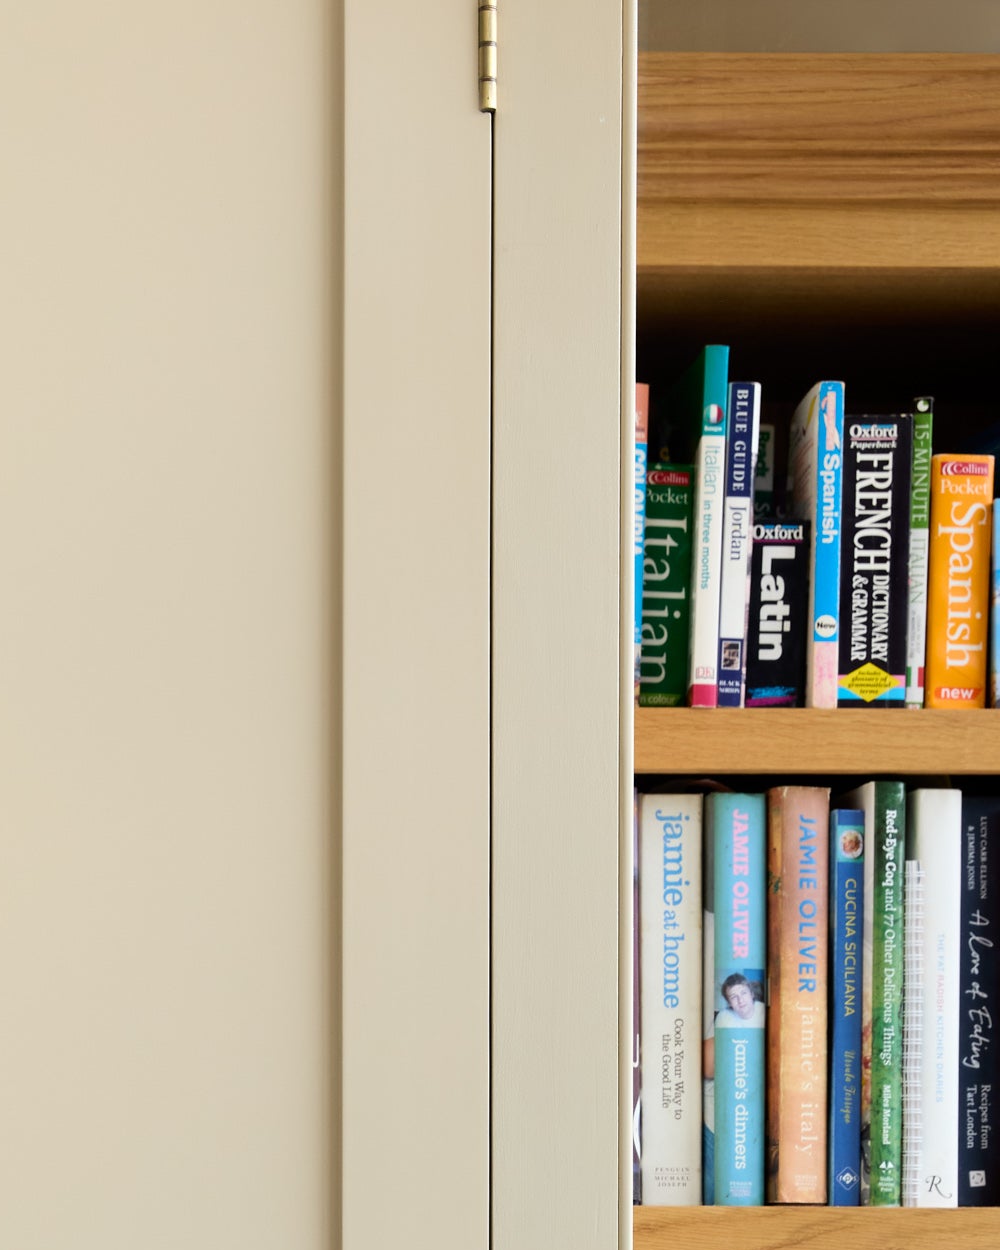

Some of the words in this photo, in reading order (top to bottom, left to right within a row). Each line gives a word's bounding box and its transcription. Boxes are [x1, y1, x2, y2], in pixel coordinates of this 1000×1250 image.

[735, 389, 749, 433] BLUE
[850, 424, 898, 438] Oxford
[850, 440, 897, 450] Paperback
[654, 473, 689, 485] Collins
[704, 445, 721, 494] Italian
[732, 441, 747, 492] GUIDE
[912, 424, 930, 522] 15-MINUTE
[954, 463, 989, 475] Collins
[703, 500, 711, 510] in
[820, 453, 840, 543] Spanish
[941, 478, 989, 495] Pocket
[702, 514, 712, 543] three
[853, 452, 894, 572] FRENCH
[729, 506, 747, 561] Jordan
[753, 524, 803, 540] Oxford
[700, 547, 711, 589] months
[938, 502, 988, 669] Spanish
[640, 516, 687, 684] Italian
[758, 545, 796, 661] Latin
[871, 574, 890, 662] DICTIONARY
[941, 688, 974, 699] new
[733, 809, 749, 876] JAMIE
[882, 809, 898, 860] Red-Eye
[980, 816, 988, 838] LUCY
[655, 809, 690, 906] jamie
[798, 815, 817, 890] JAMIE
[882, 862, 896, 887] Coq
[967, 866, 975, 891] JONES
[845, 878, 857, 938] CUCINA
[885, 889, 896, 912] and
[968, 909, 990, 927] A
[664, 910, 680, 930] at
[733, 881, 749, 959] OLIVER
[883, 914, 895, 927] 77
[798, 899, 817, 993] OLIVER
[884, 929, 896, 964] Other
[663, 933, 685, 1008] home
[844, 942, 857, 1017] SICILIANA
[883, 968, 895, 1024] Delicious
[662, 1034, 671, 1052] the
[674, 1018, 684, 1049] Cook
[796, 1002, 819, 1091] jamie's
[880, 1026, 895, 1066] Things
[662, 1054, 671, 1084] Good
[674, 1051, 684, 1079] Your
[732, 1039, 749, 1100] jamie's
[662, 1086, 672, 1109] Life
[674, 1081, 684, 1109] Way
[882, 1084, 892, 1107] Miles
[966, 1086, 977, 1104] Tart
[979, 1084, 992, 1122] Recipes
[674, 1110, 682, 1120] to
[794, 1103, 819, 1156] italy
[882, 1108, 892, 1145] Morland
[966, 1106, 977, 1149] London
[735, 1103, 749, 1170] dinners
[979, 1124, 992, 1150] from
